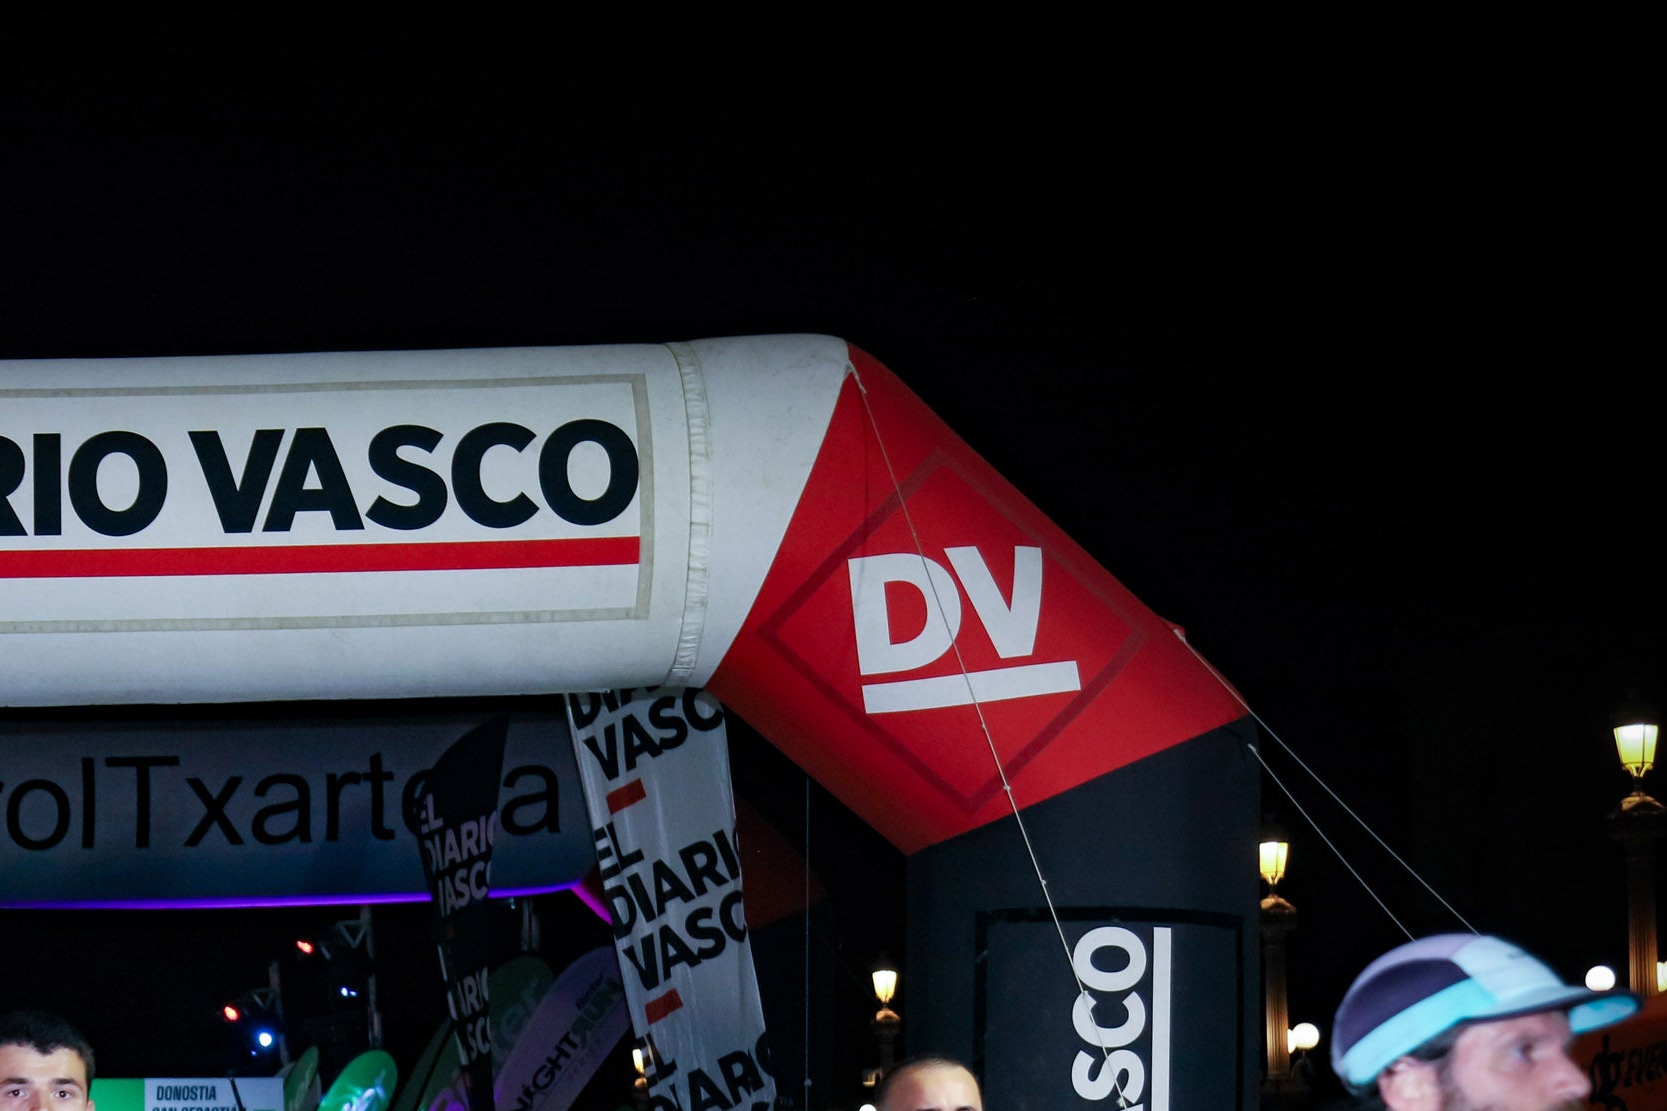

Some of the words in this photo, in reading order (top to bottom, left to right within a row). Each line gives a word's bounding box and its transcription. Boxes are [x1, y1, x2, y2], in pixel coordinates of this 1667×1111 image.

[187, 418, 640, 535] VASCO
[847, 545, 1044, 676] DV
[583, 690, 725, 780] VASC
[604, 829, 741, 939] DIARI
[623, 890, 748, 991] VASC
[156, 1085, 217, 1101] DONOSTIA
